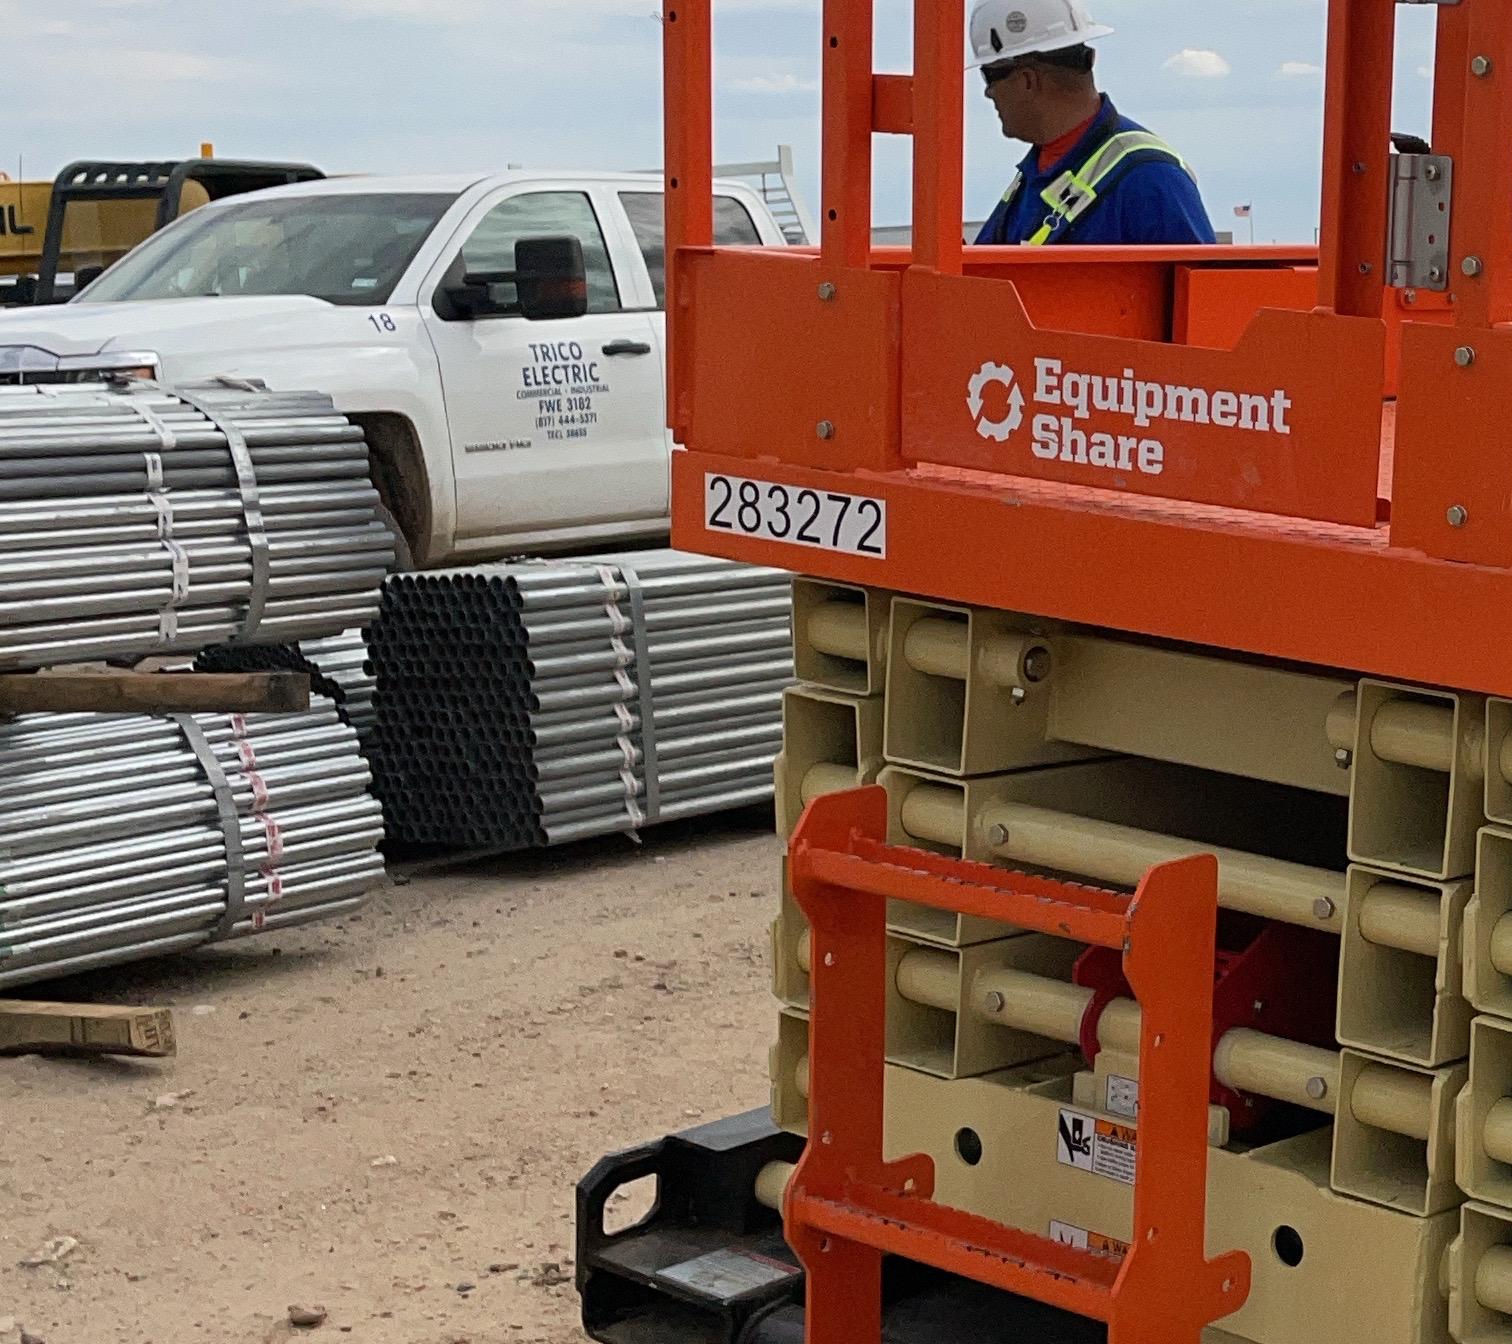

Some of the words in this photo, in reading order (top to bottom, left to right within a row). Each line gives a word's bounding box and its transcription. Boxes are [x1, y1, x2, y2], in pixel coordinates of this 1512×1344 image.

[368, 312, 396, 333] 18
[528, 341, 583, 363] TRICO
[522, 362, 600, 387] ELECTRIC
[516, 387, 562, 400] COMMERCIAL
[1033, 357, 1292, 434] Equipment
[539, 399, 562, 414] FWE
[1031, 415, 1165, 476] Share
[708, 476, 882, 554] 283272
